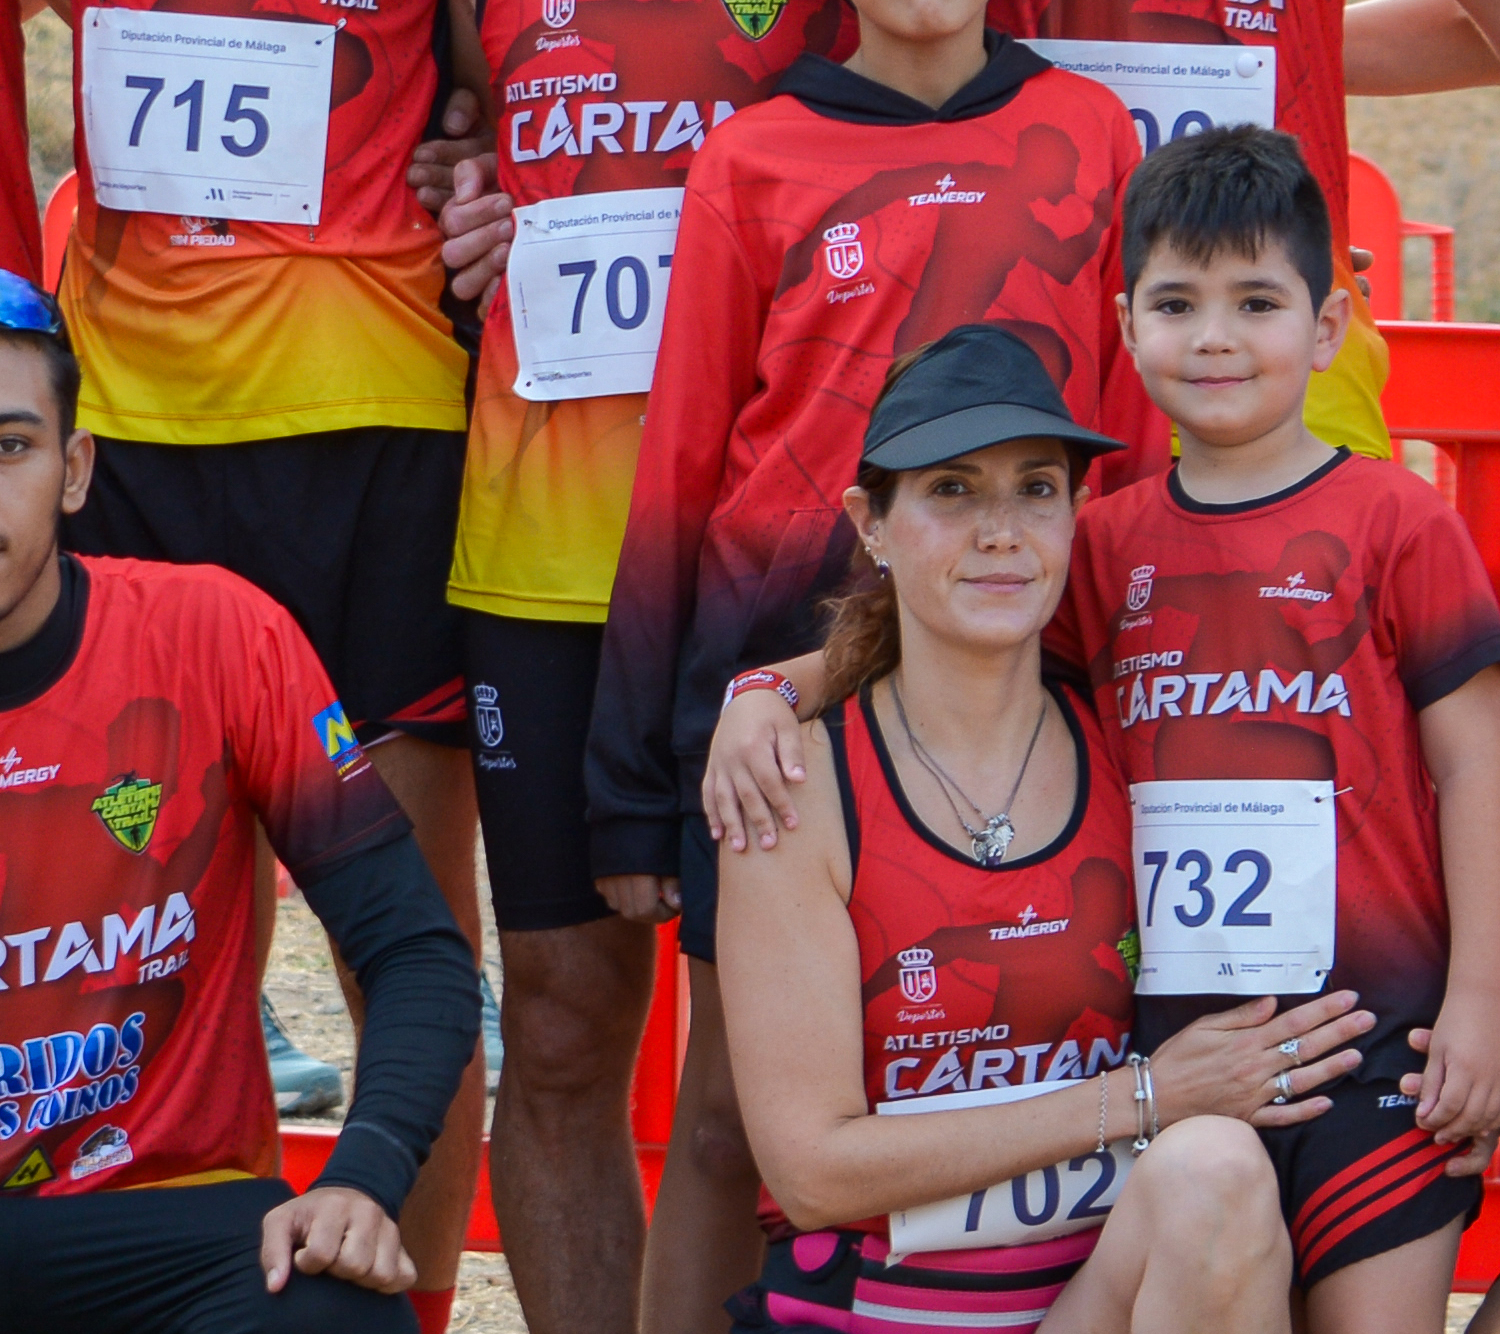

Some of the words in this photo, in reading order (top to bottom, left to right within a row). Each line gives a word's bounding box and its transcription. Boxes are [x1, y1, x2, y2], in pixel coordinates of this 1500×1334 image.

[1224, 6, 1278, 33] TRAIL
[120, 29, 172, 45] Diputación
[174, 33, 226, 49] Provincial
[228, 38, 243, 50] de
[245, 38, 287, 55] Málaga
[535, 34, 581, 52] Deportes
[1053, 60, 1113, 74] Diputación
[1115, 62, 1170, 76] Provincial
[1173, 65, 1188, 76] de
[1190, 63, 1231, 79] Málaga
[505, 71, 617, 104] ATLETISMO
[125, 75, 272, 158] 715
[511, 96, 737, 163] CÁRTA
[907, 190, 987, 207] TEAMERGY
[548, 213, 600, 231] Diputación
[601, 209, 655, 224] Provincial
[657, 208, 671, 220] de
[190, 234, 236, 247] PIEDAD
[558, 253, 674, 336] 70
[826, 282, 876, 305] Deportes
[1258, 585, 1333, 603] TEAMERGY
[1116, 672, 1352, 730] CÁRTAMA
[1174, 801, 1223, 815] Provincial
[1224, 801, 1239, 814] de
[1241, 800, 1285, 817] Málaga
[1142, 848, 1273, 928] 732
[989, 918, 1070, 941] TEAMERGY
[138, 952, 190, 986] TRAIL
[896, 1007, 946, 1024] Deportes
[884, 1023, 1010, 1052] ATLETISMO
